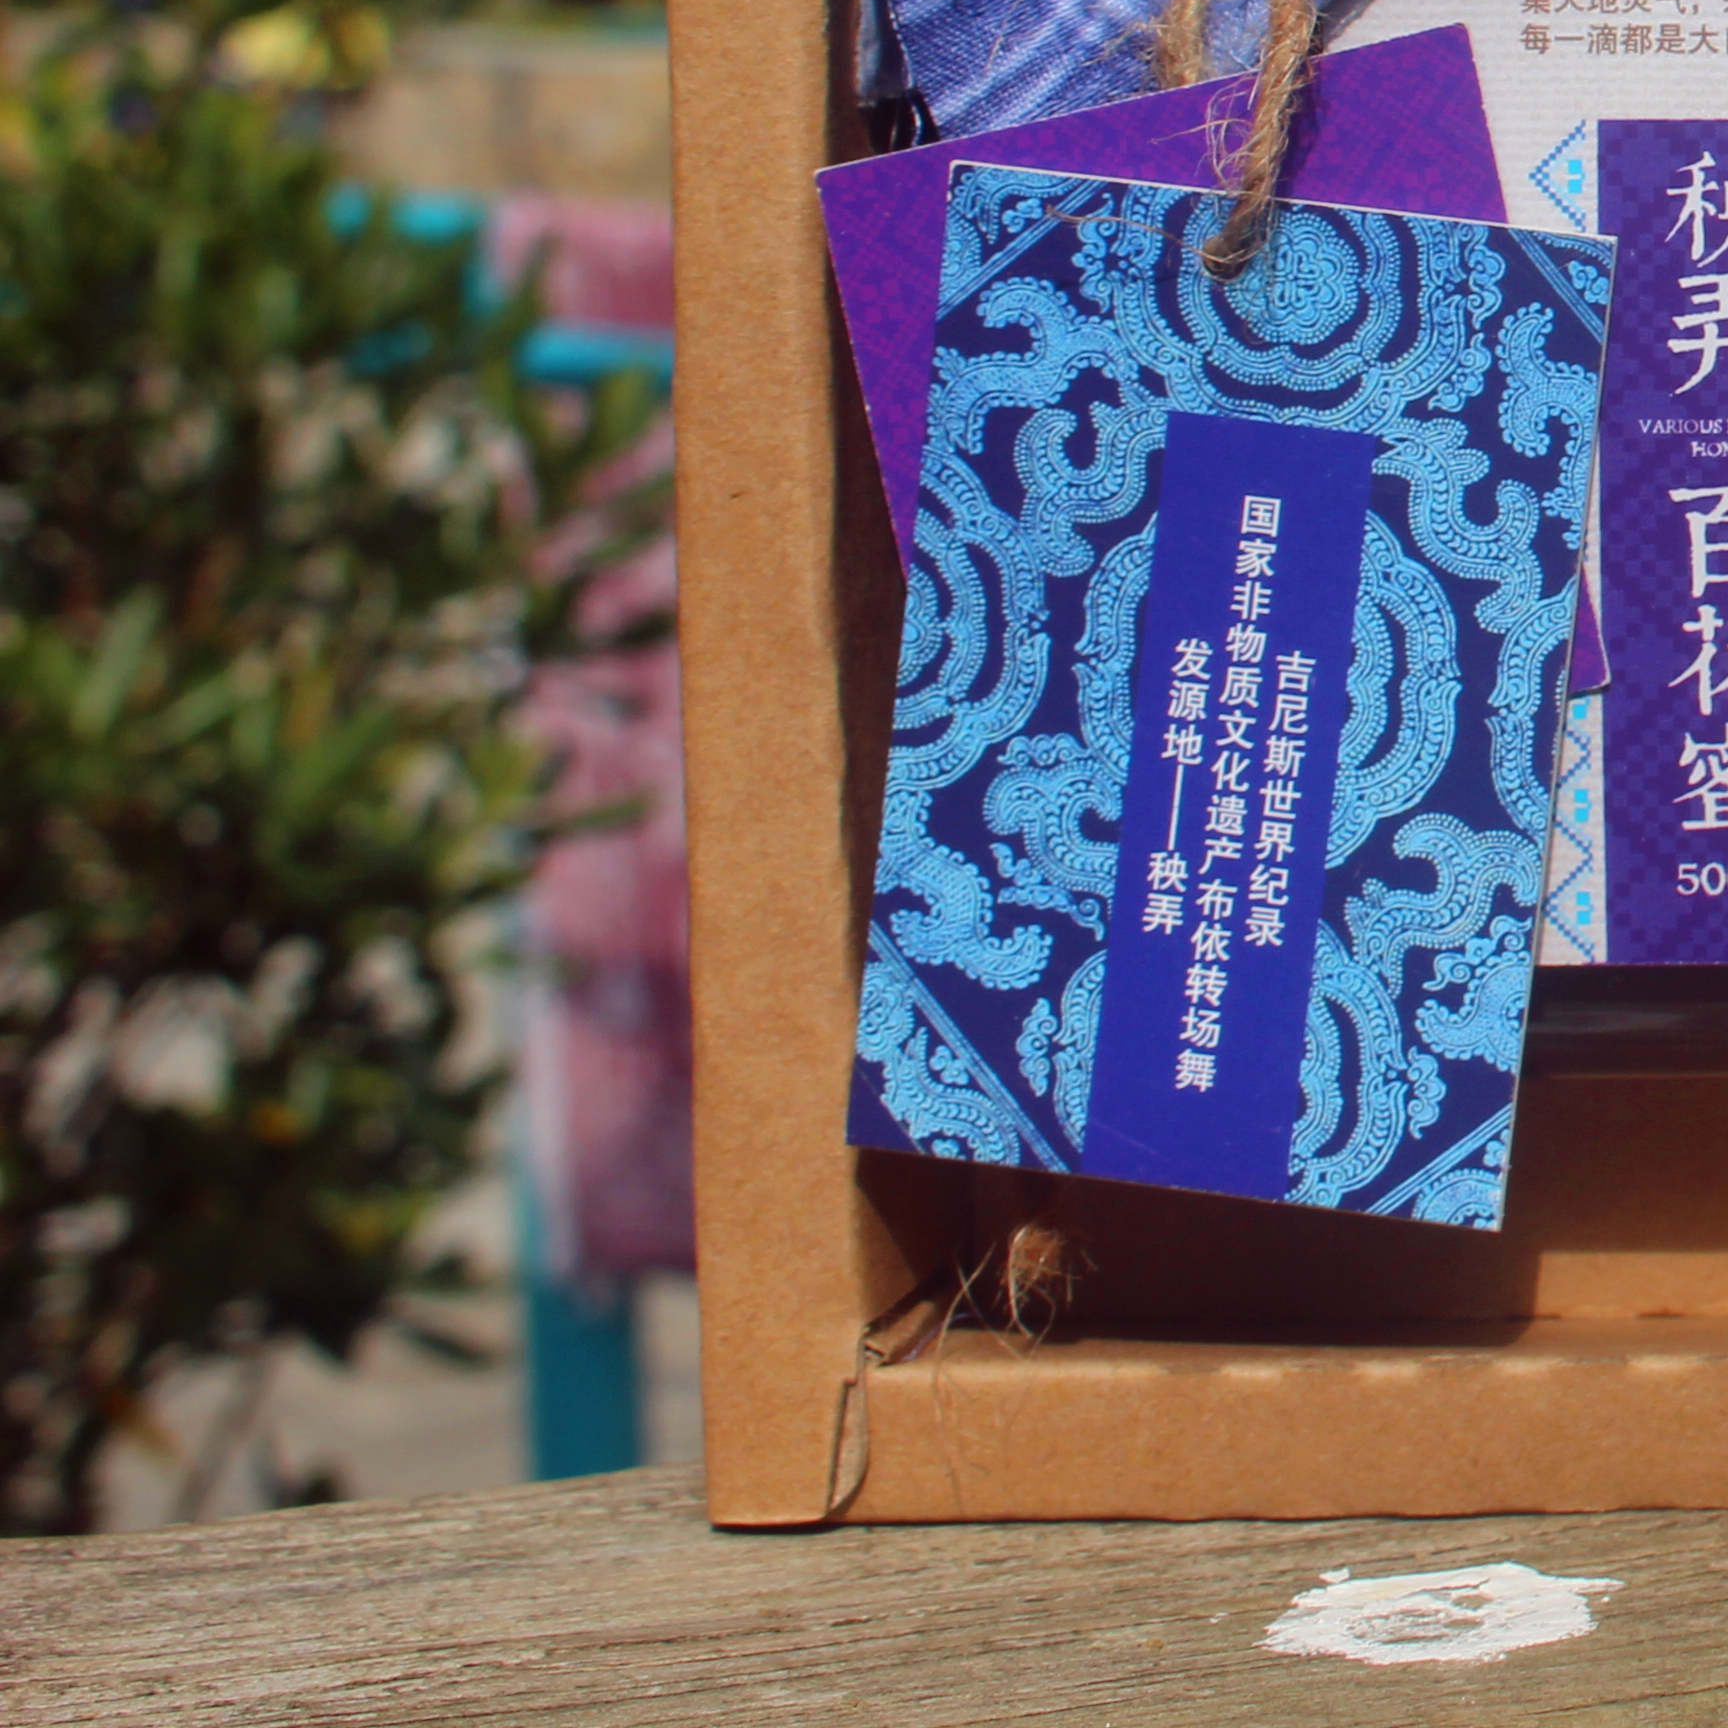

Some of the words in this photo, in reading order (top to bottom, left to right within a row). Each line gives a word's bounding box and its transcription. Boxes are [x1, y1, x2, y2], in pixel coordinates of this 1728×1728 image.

[1639, 419, 1722, 434] VARIOUS
[1175, 494, 1282, 1094] 国家非物质文化遗产布依转场舞
[1244, 649, 1317, 948] 吉尼斯世界纪录
